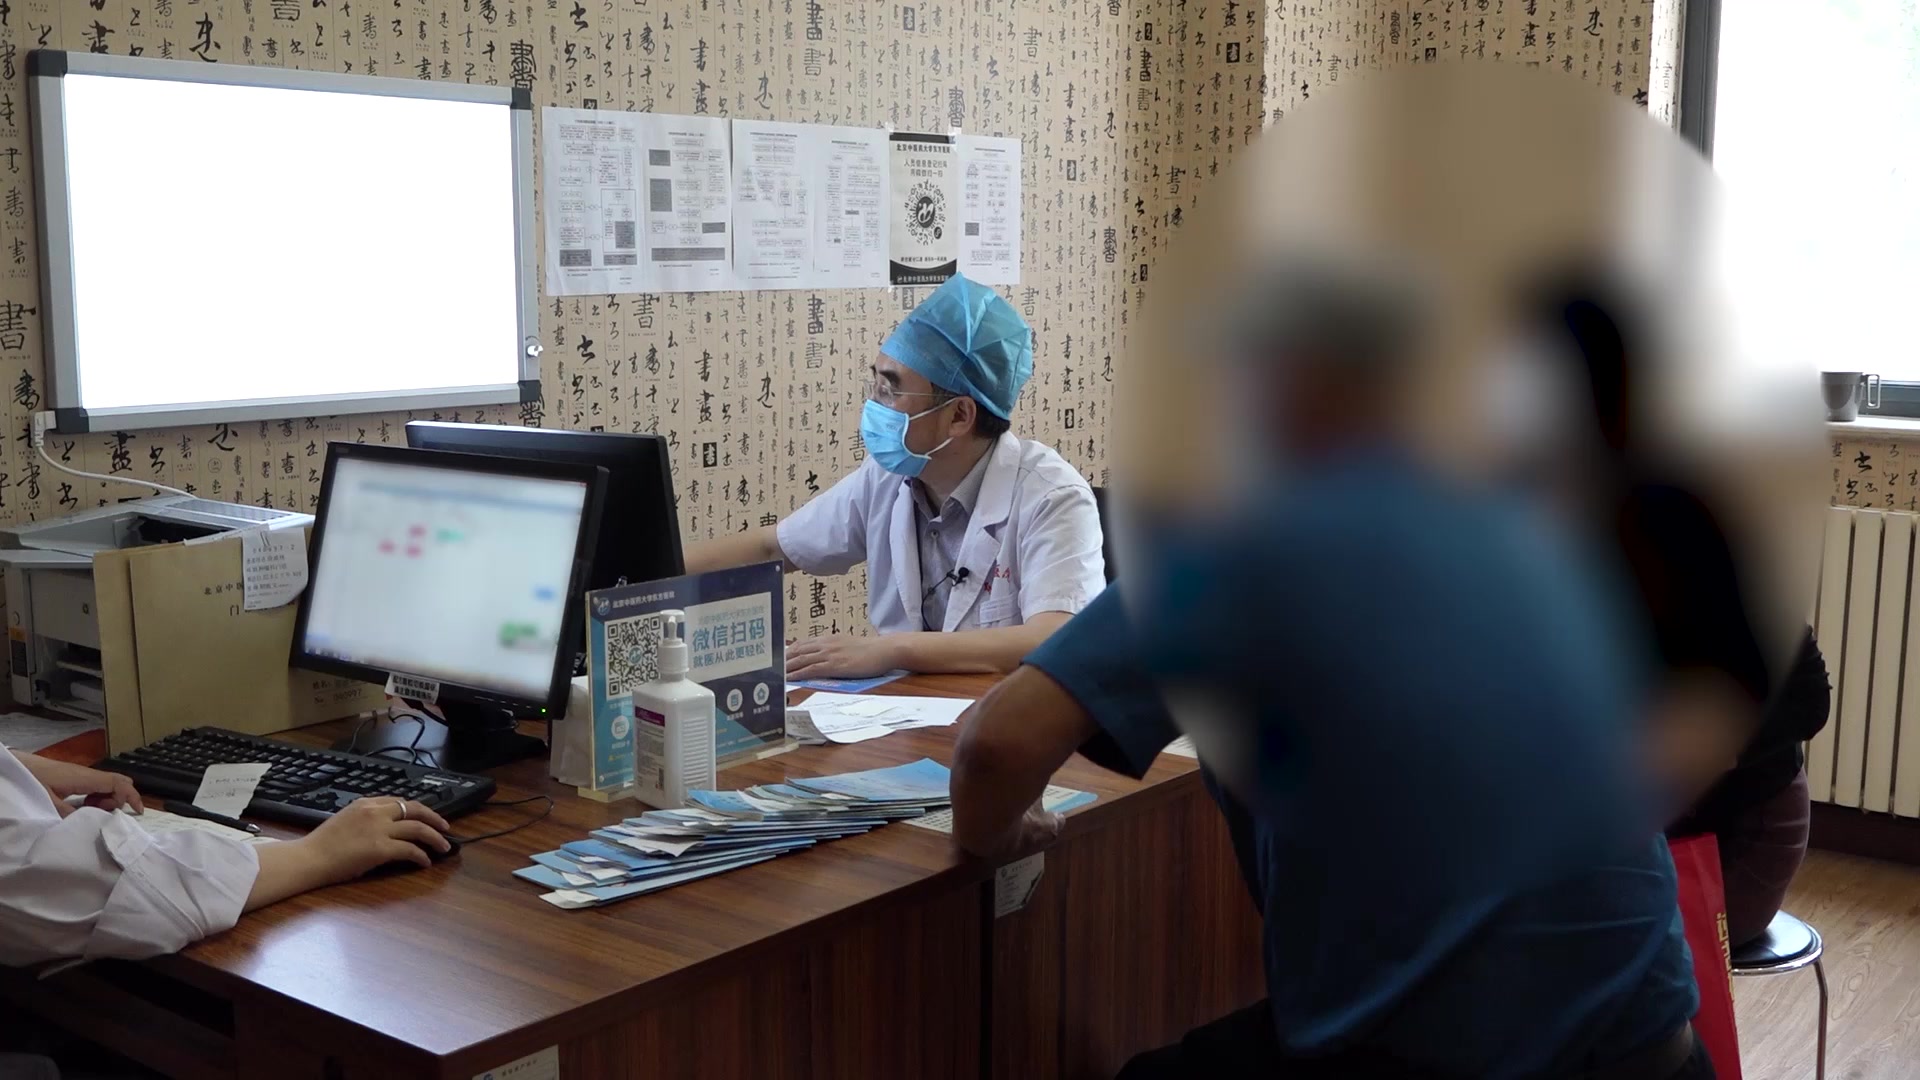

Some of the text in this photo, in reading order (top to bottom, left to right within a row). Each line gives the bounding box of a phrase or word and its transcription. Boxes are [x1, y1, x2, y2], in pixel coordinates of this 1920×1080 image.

[692, 617, 765, 652] 微信扫码
[693, 642, 766, 668] 就医从此更轻松
